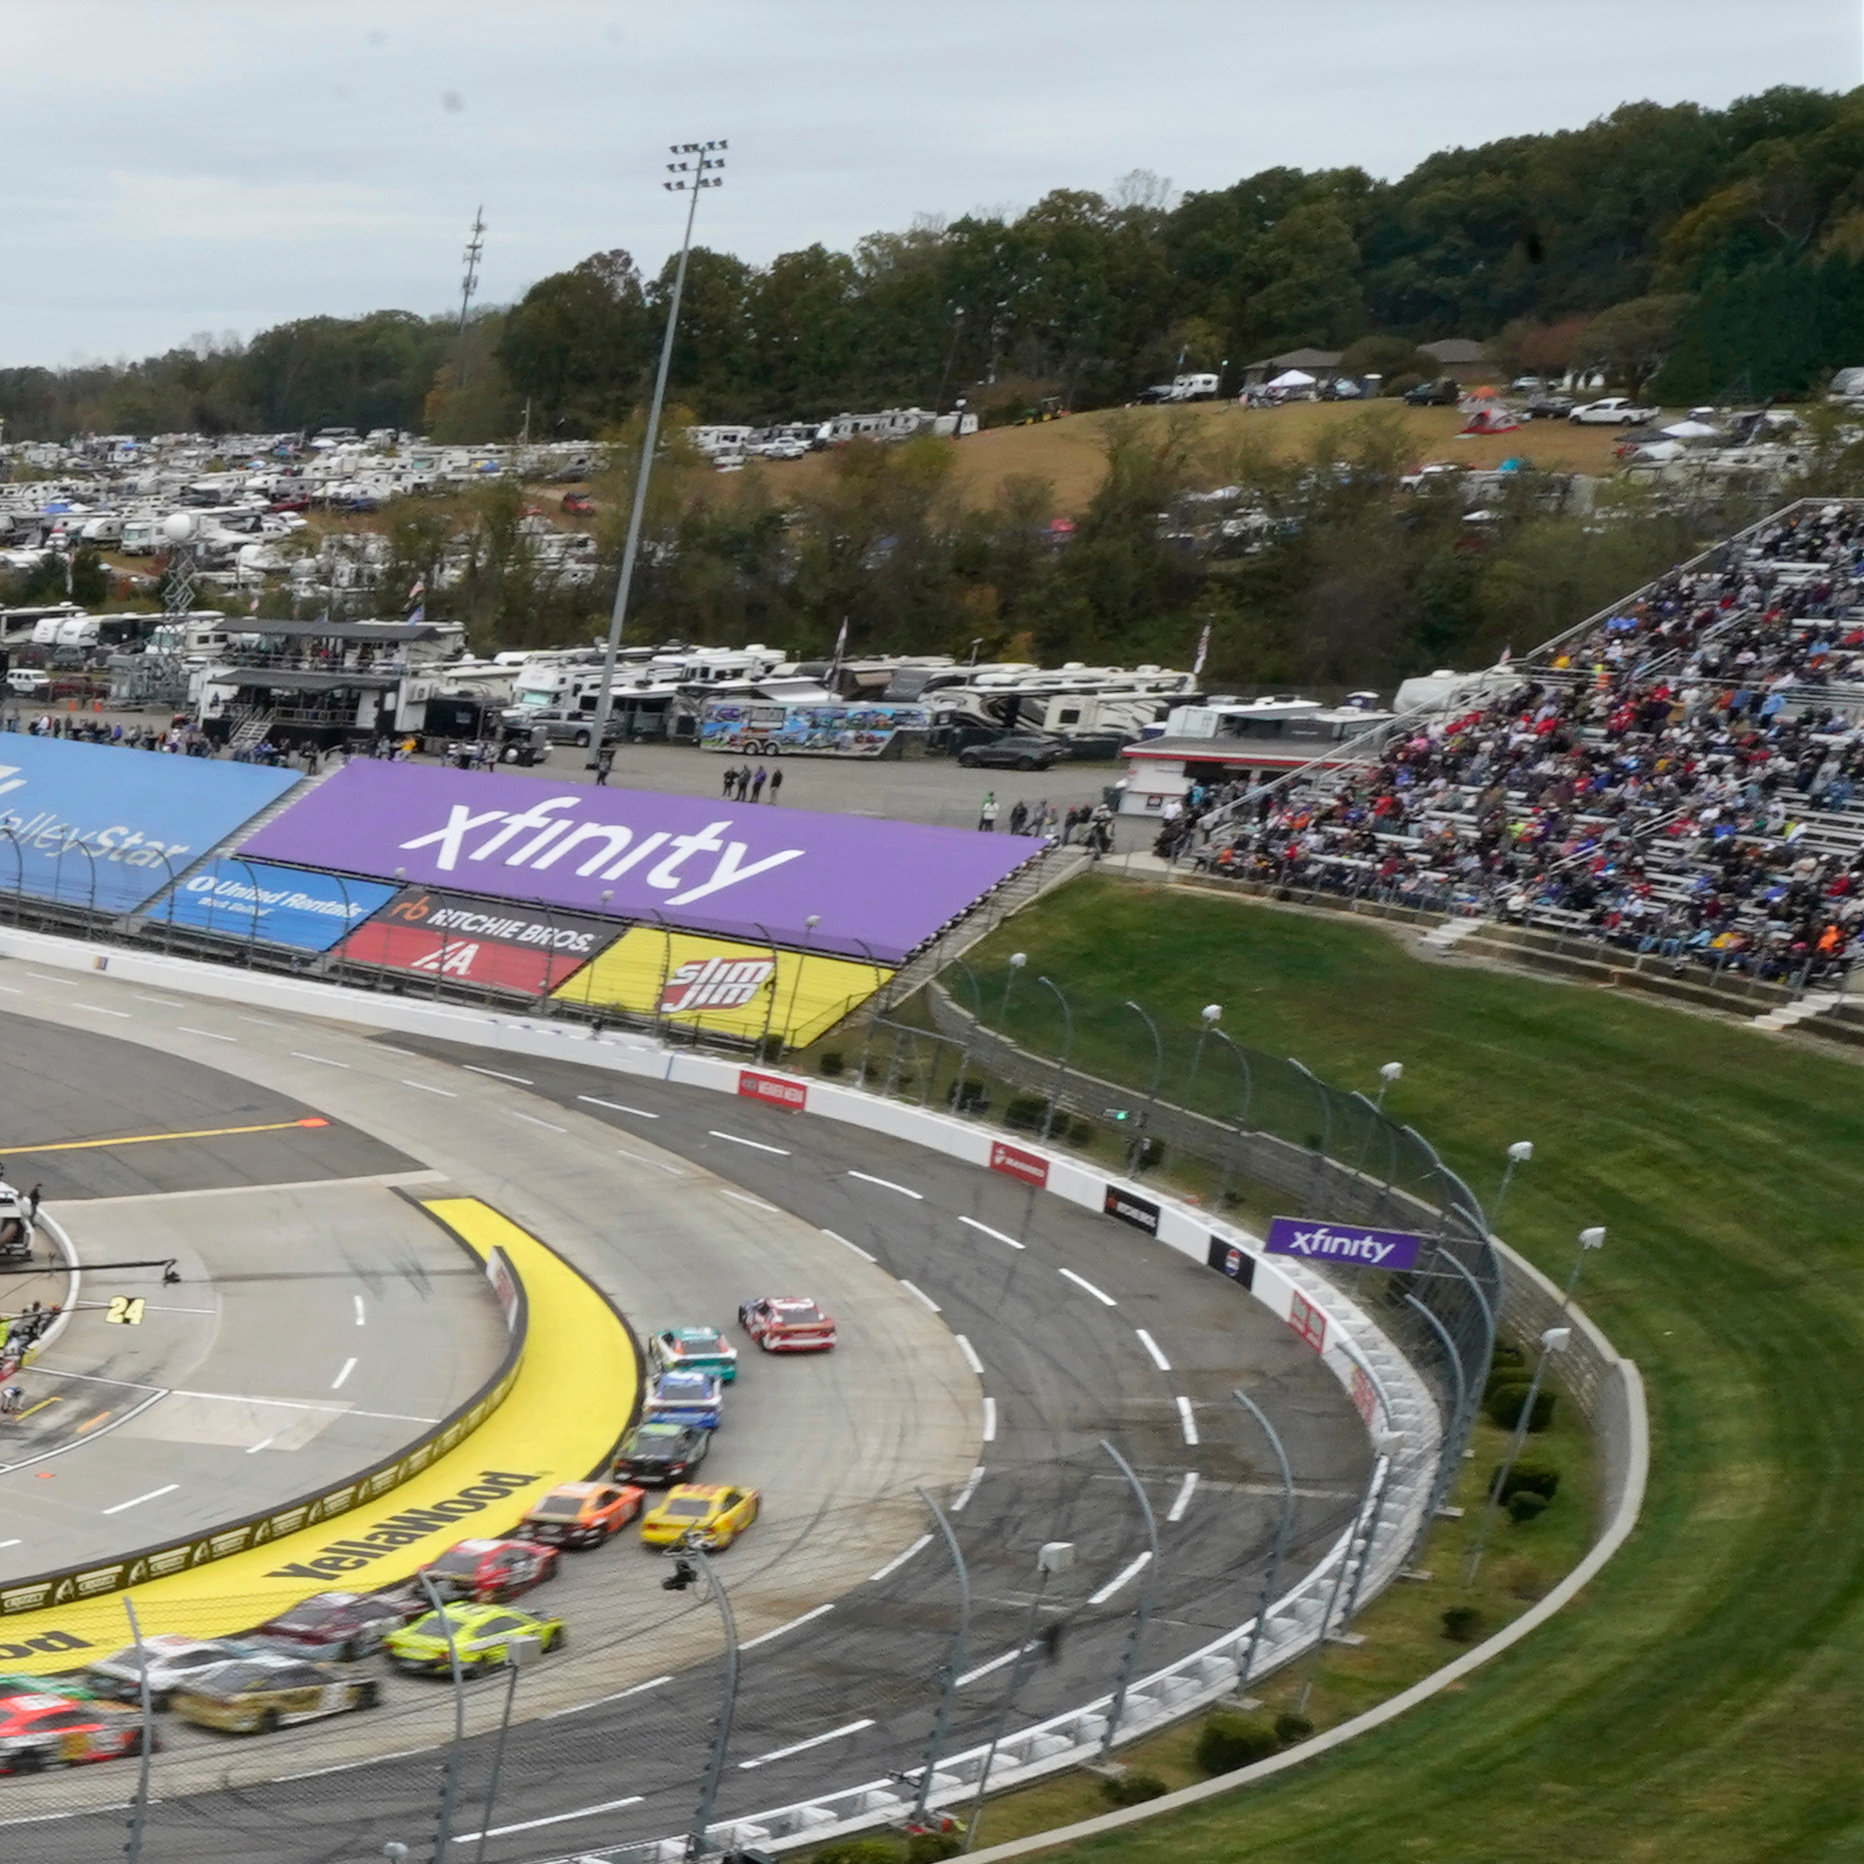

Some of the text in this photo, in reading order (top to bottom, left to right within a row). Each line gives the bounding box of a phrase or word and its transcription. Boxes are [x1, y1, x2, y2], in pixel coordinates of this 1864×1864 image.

[400, 796, 805, 906] xfinity
[215, 881, 369, 918] United Rentals
[428, 909, 594, 953] RITCHIE BROS.
[666, 957, 775, 986] slim
[661, 982, 760, 1013] jim
[1290, 1228, 1396, 1263] xfinity
[106, 1296, 146, 1325] 24
[264, 1471, 543, 1583] YellaWood
